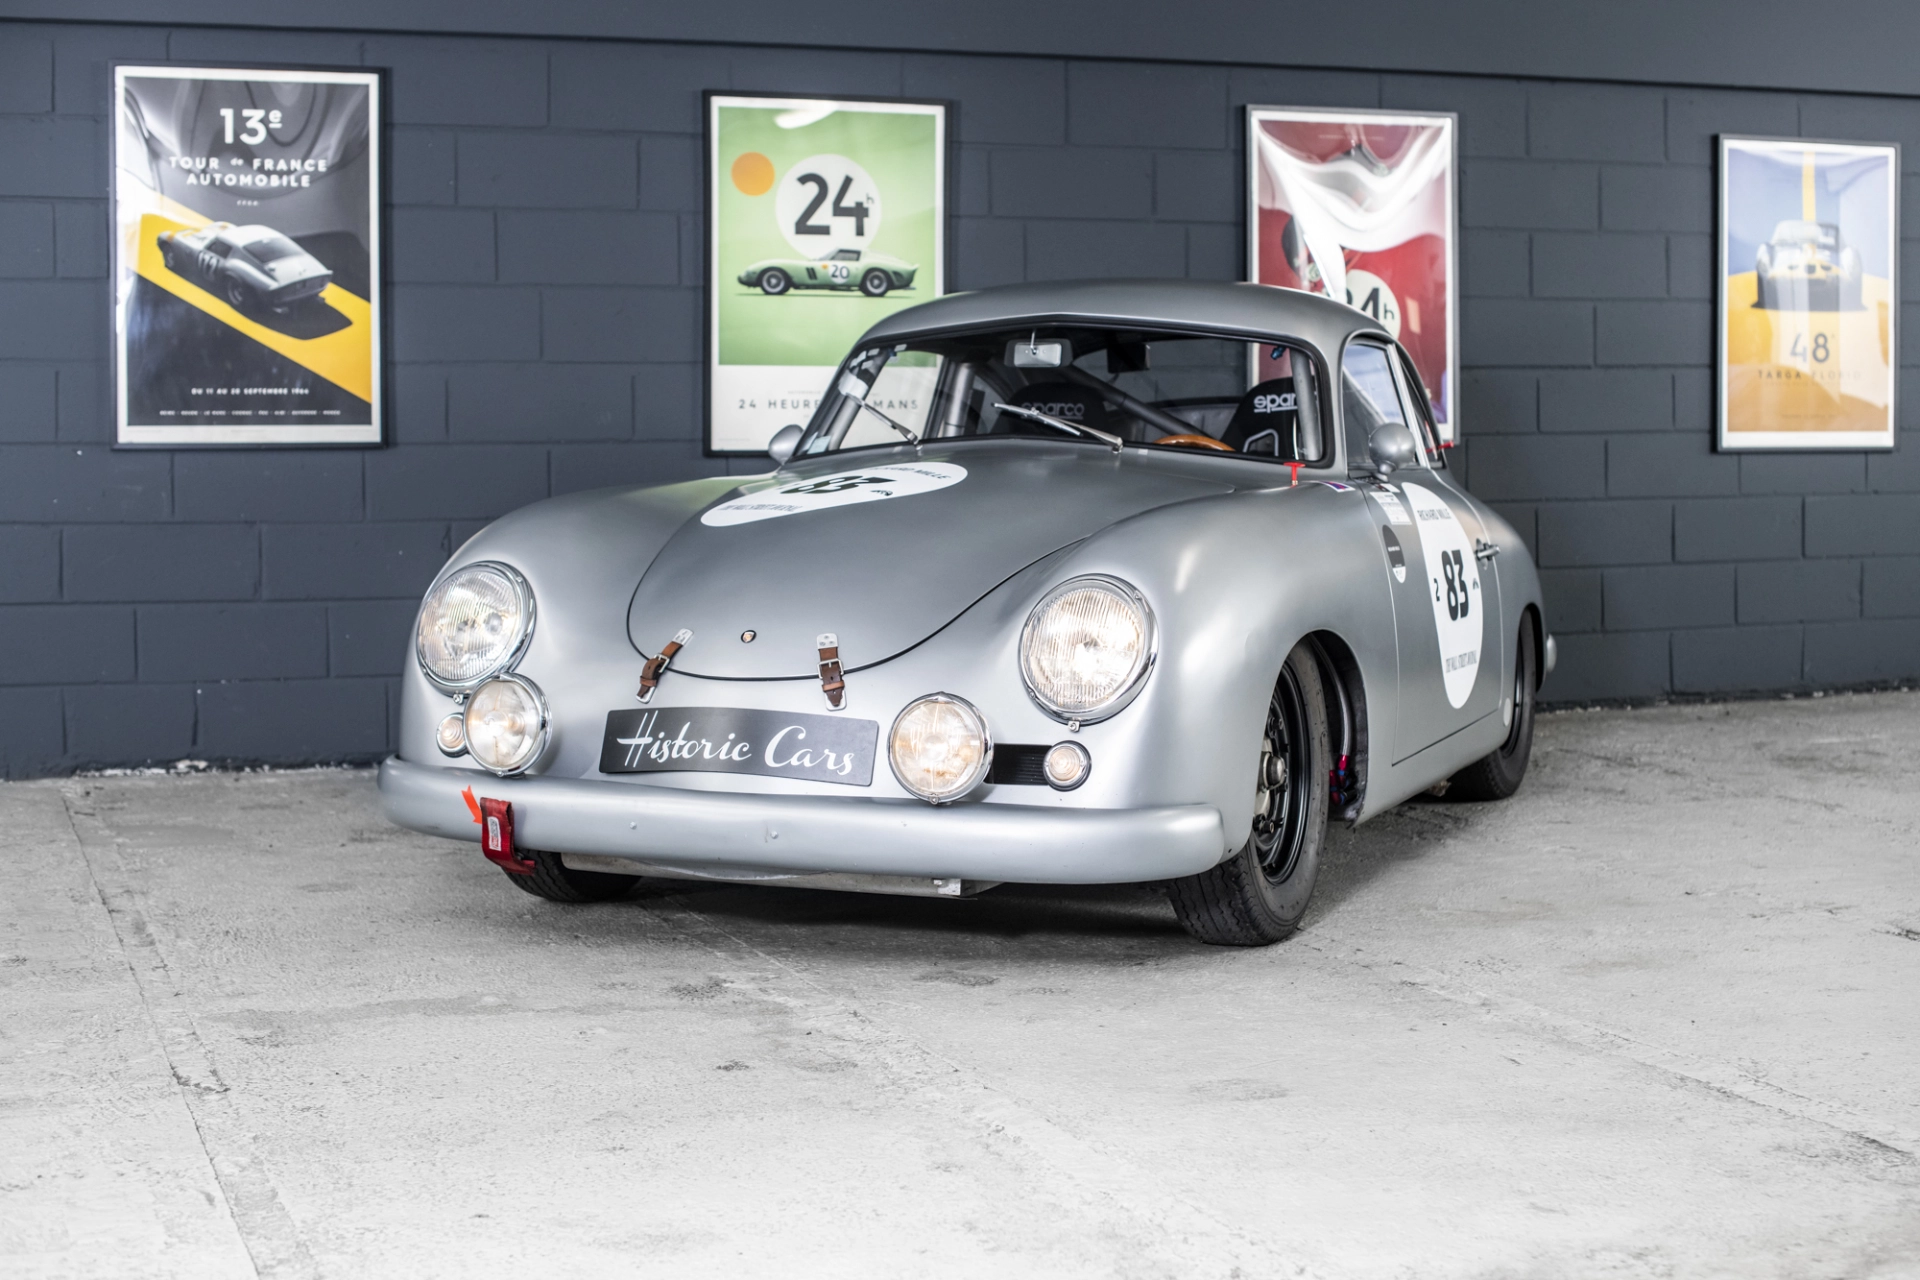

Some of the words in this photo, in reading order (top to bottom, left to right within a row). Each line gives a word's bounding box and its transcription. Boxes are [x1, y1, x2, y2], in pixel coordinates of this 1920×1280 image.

[169, 157, 219, 169] TOUR
[230, 158, 244, 166] de
[253, 158, 327, 172] FRANCE
[186, 173, 311, 187] AUTOMOBILE
[831, 265, 849, 279] 20
[1346, 287, 1394, 320] 4h
[1790, 333, 1829, 363] 48
[1758, 369, 1801, 379] TARGA
[738, 399, 756, 409] 24
[873, 399, 919, 410] MANS
[1442, 549, 1469, 621] 83
[617, 710, 752, 768] Historic
[765, 725, 855, 776] Cars
